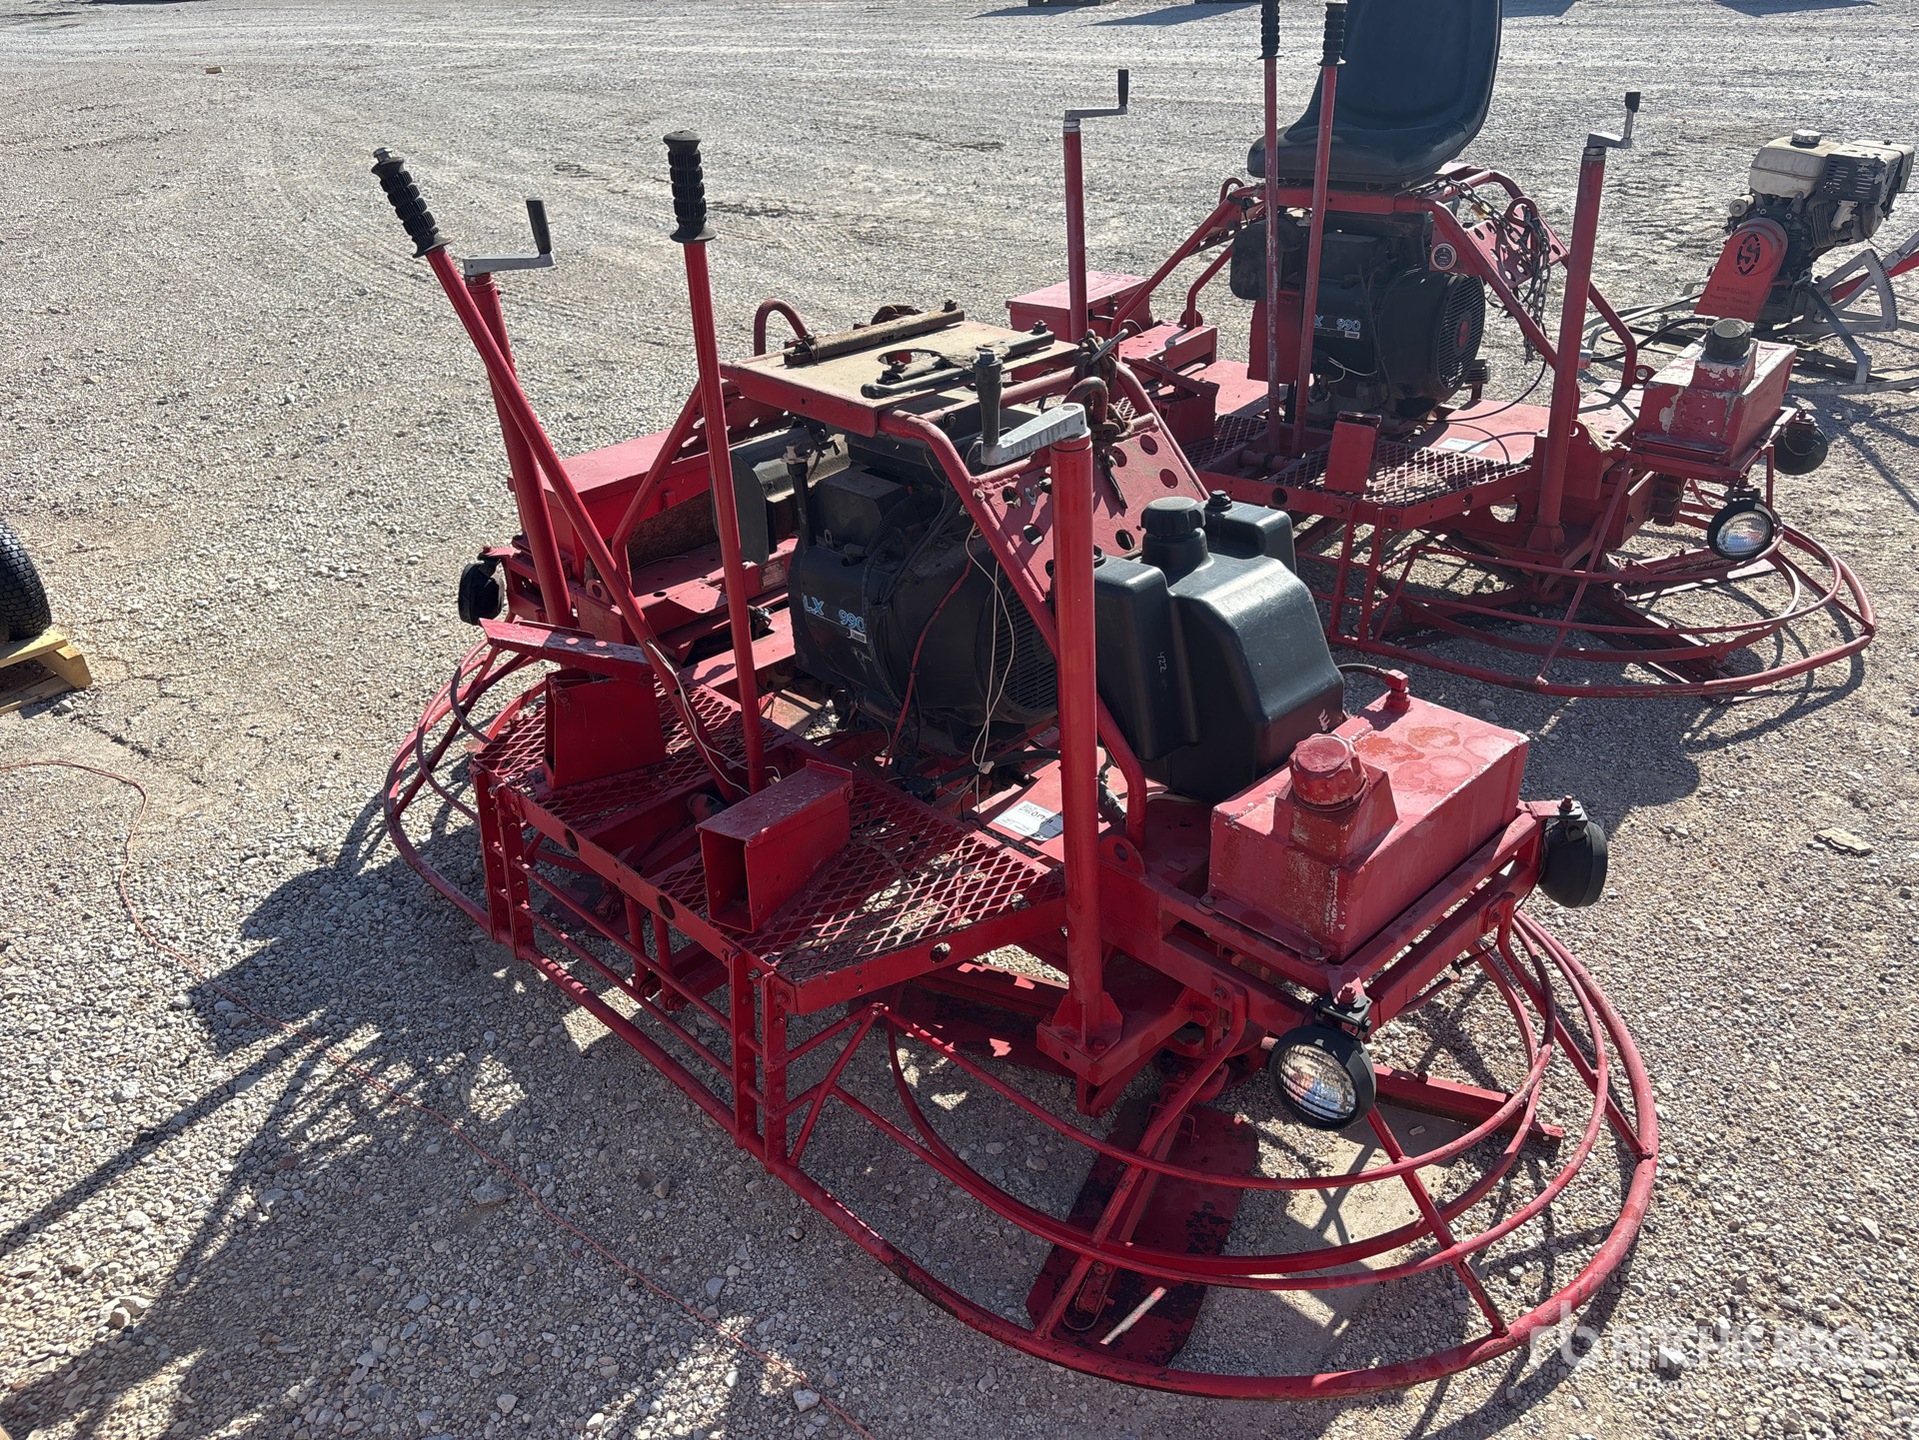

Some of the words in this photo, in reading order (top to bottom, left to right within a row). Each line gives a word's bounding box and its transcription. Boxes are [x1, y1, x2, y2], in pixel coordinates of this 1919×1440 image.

[1336, 318, 1361, 332] 990
[802, 594, 824, 616] LX
[838, 609, 865, 633] 990
